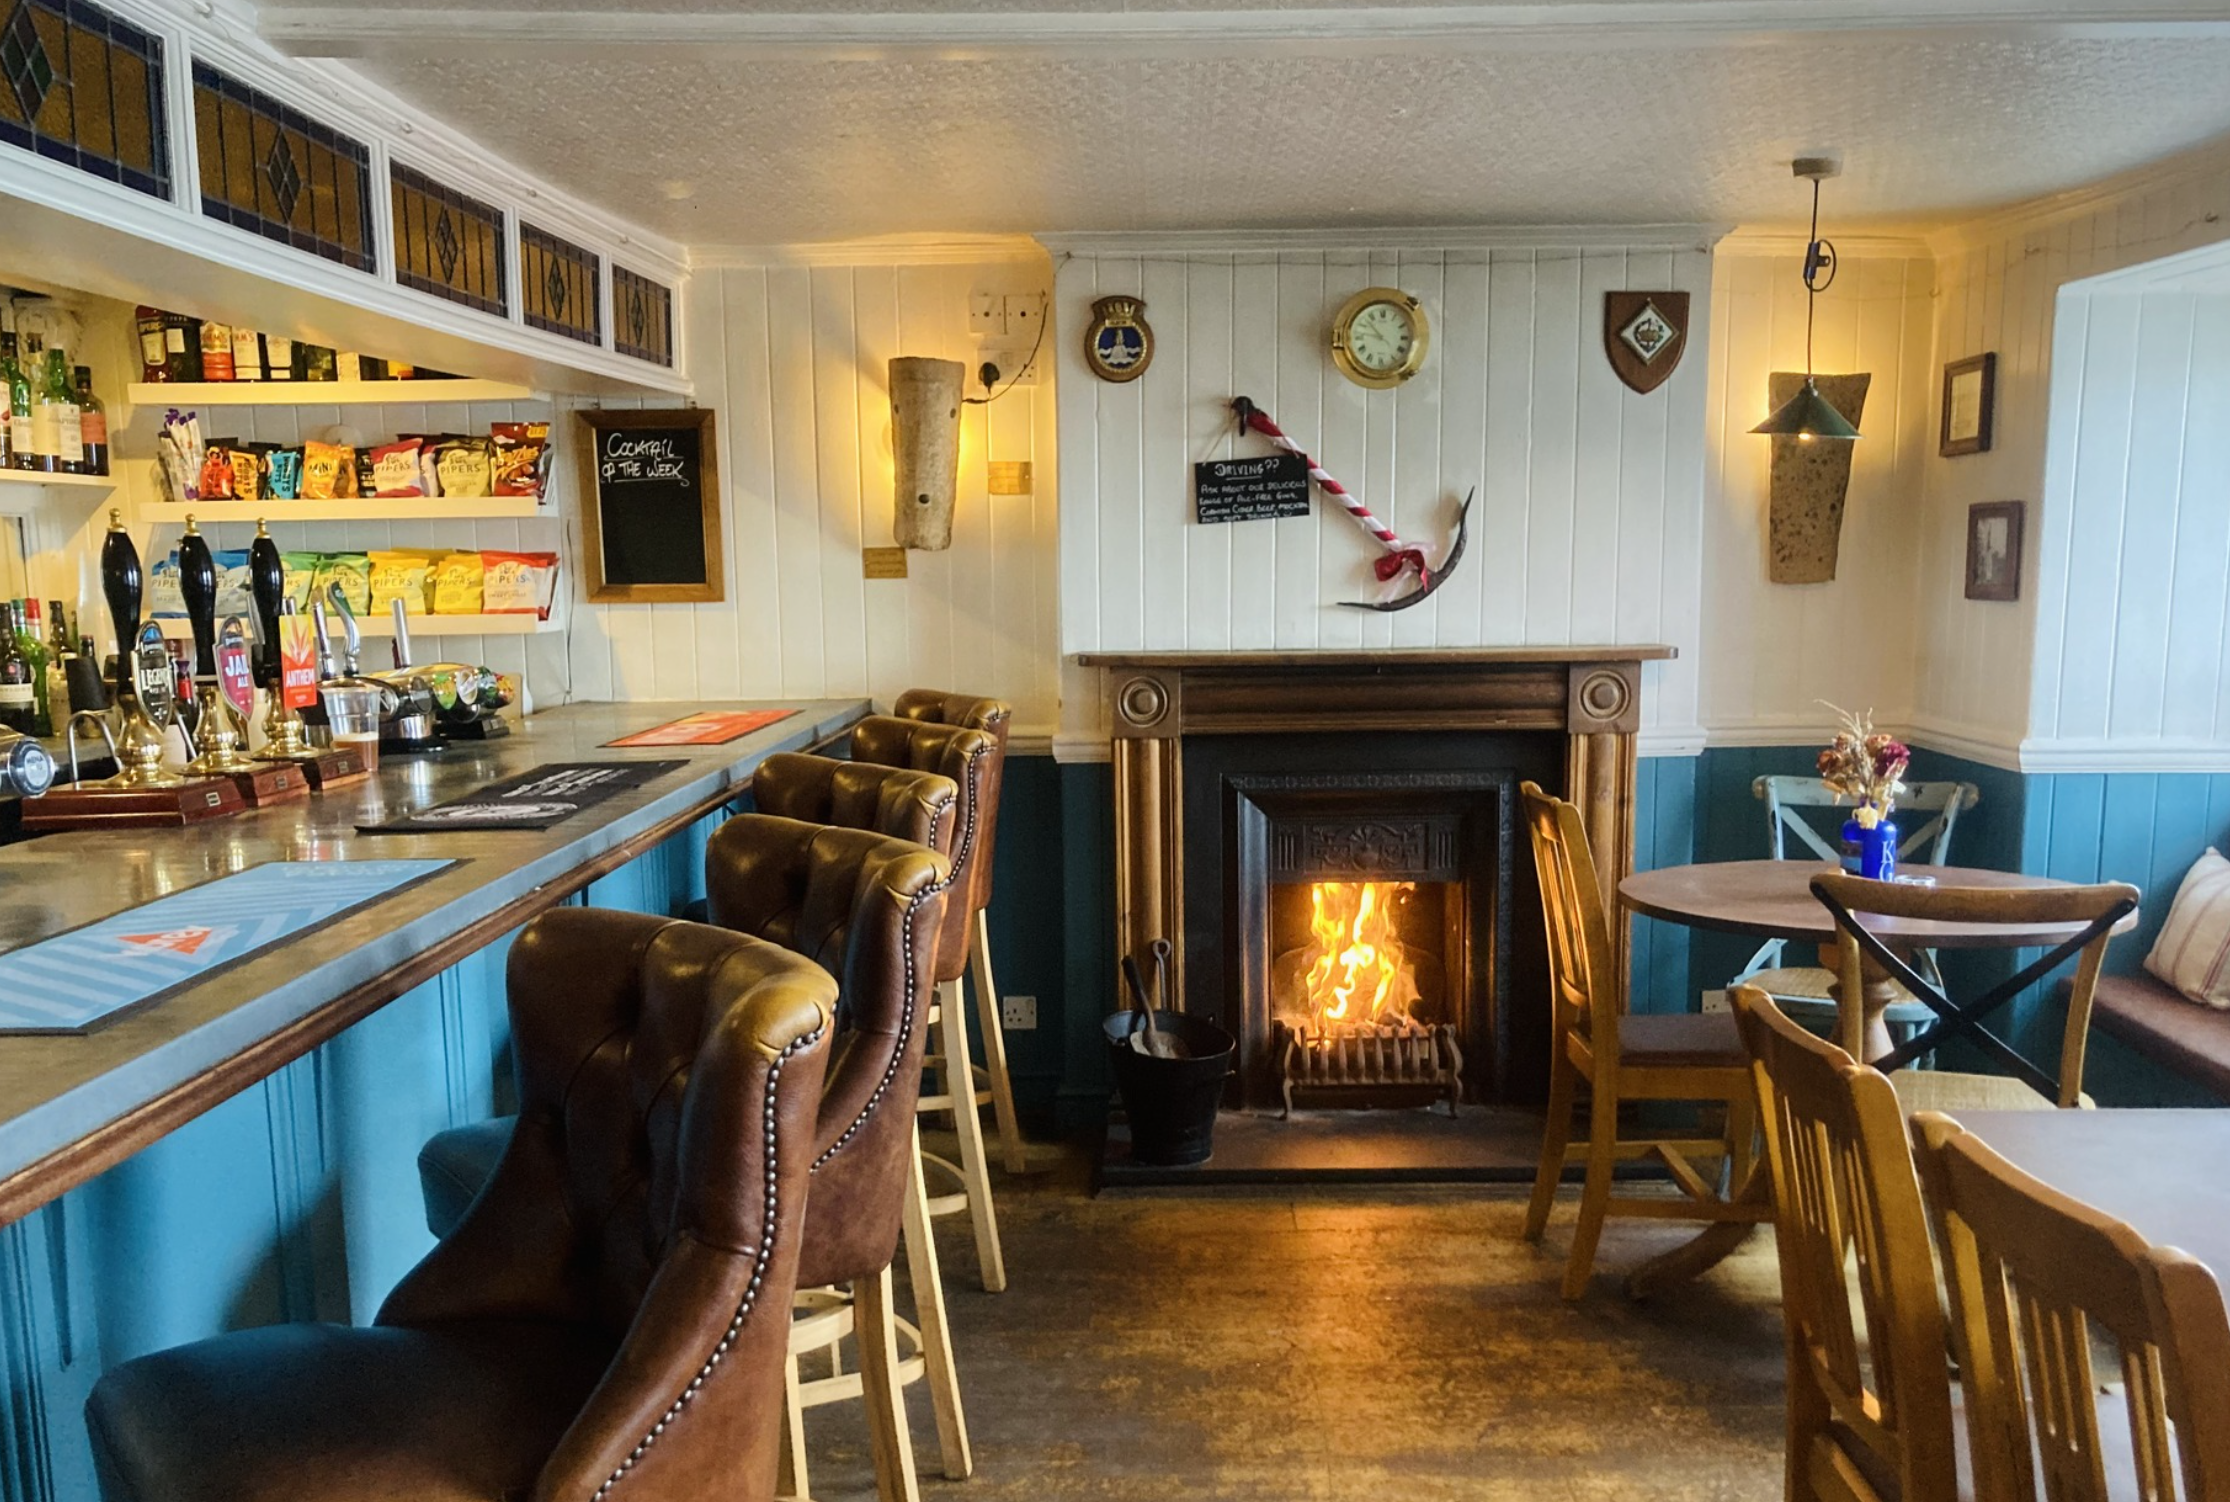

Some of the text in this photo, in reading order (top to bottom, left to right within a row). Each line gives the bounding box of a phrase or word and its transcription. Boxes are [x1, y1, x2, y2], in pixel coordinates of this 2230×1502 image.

[606, 432, 675, 461] COCKTAIL
[375, 461, 411, 473] PIPERS
[440, 463, 481, 475] PIPERS
[601, 460, 685, 483] OF THE WEEK
[152, 578, 176, 589] PIPE
[374, 577, 413, 588] PIPERS
[437, 577, 472, 588] PIPERS
[237, 676, 249, 688] ALE
[285, 667, 315, 688] ANTHEM
[1881, 840, 1895, 863] K
